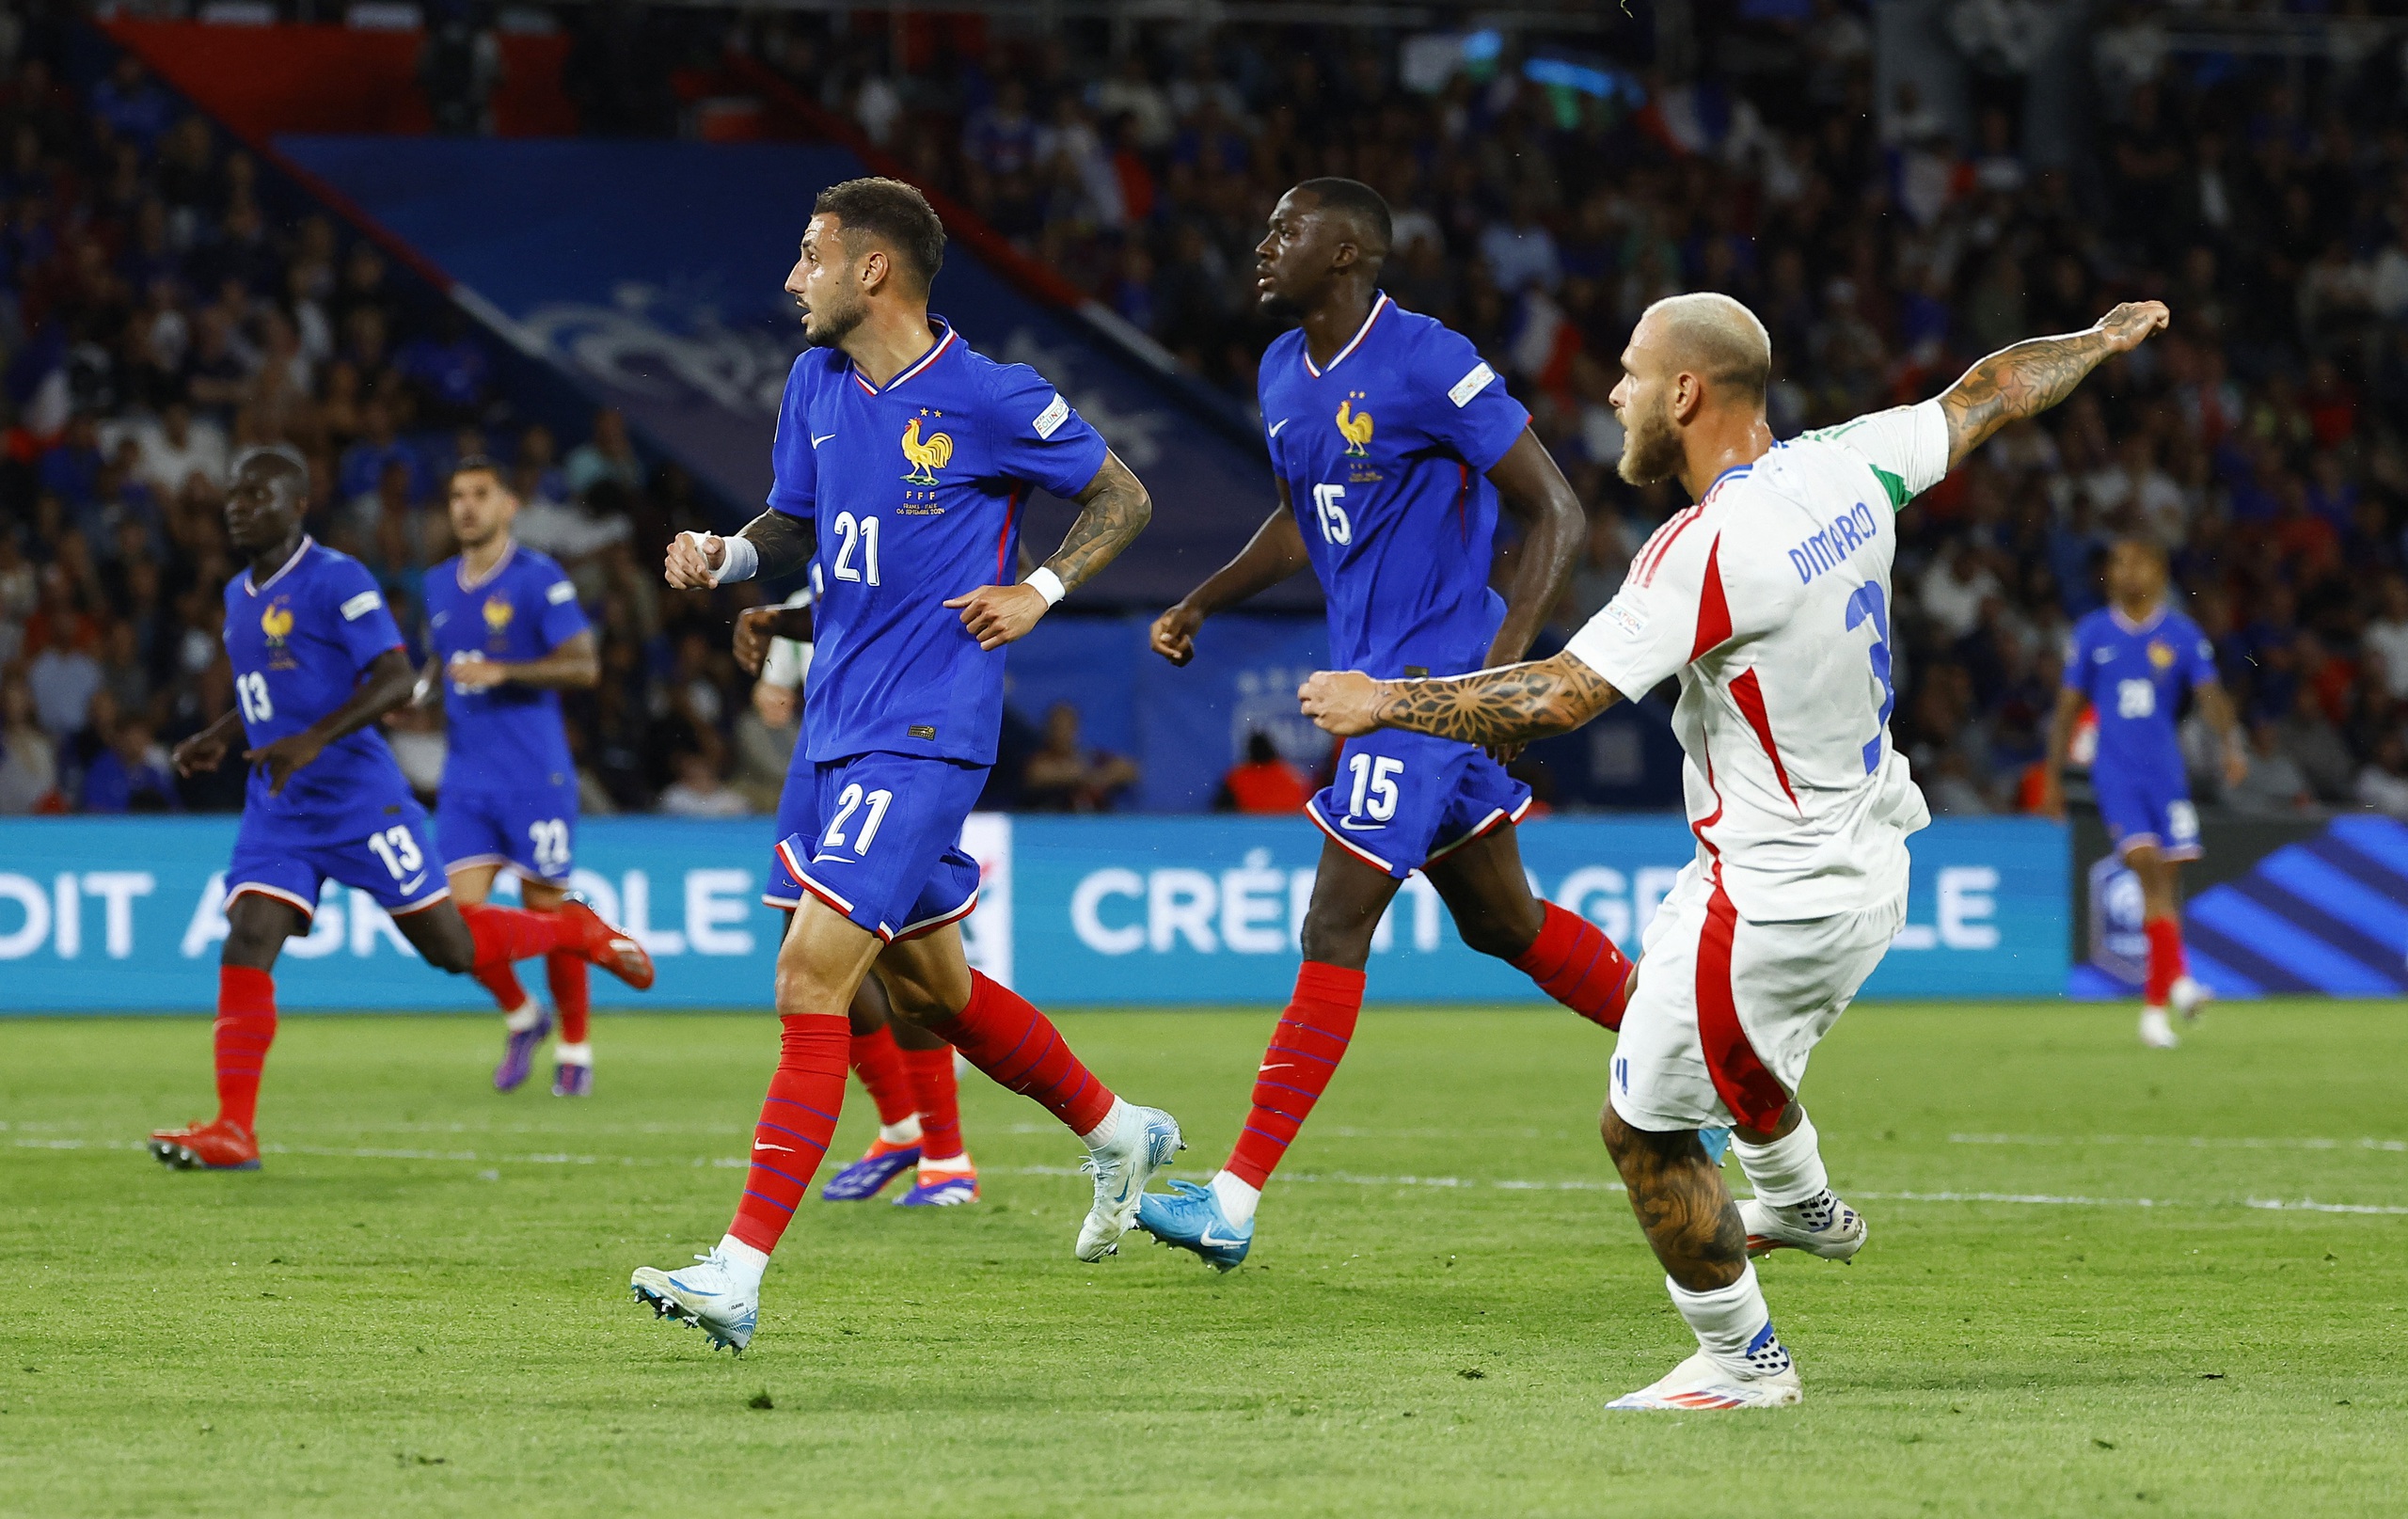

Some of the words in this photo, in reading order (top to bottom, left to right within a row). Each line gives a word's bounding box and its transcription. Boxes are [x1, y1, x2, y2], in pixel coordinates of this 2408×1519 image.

[833, 511, 880, 587] 21
[1313, 483, 1352, 546] 15
[236, 671, 274, 724] 13
[1846, 579, 1893, 776] 3
[823, 783, 893, 857] 21
[1349, 752, 1404, 821] 15
[368, 825, 422, 881] 13
[1070, 847, 1442, 954] CRÉT
